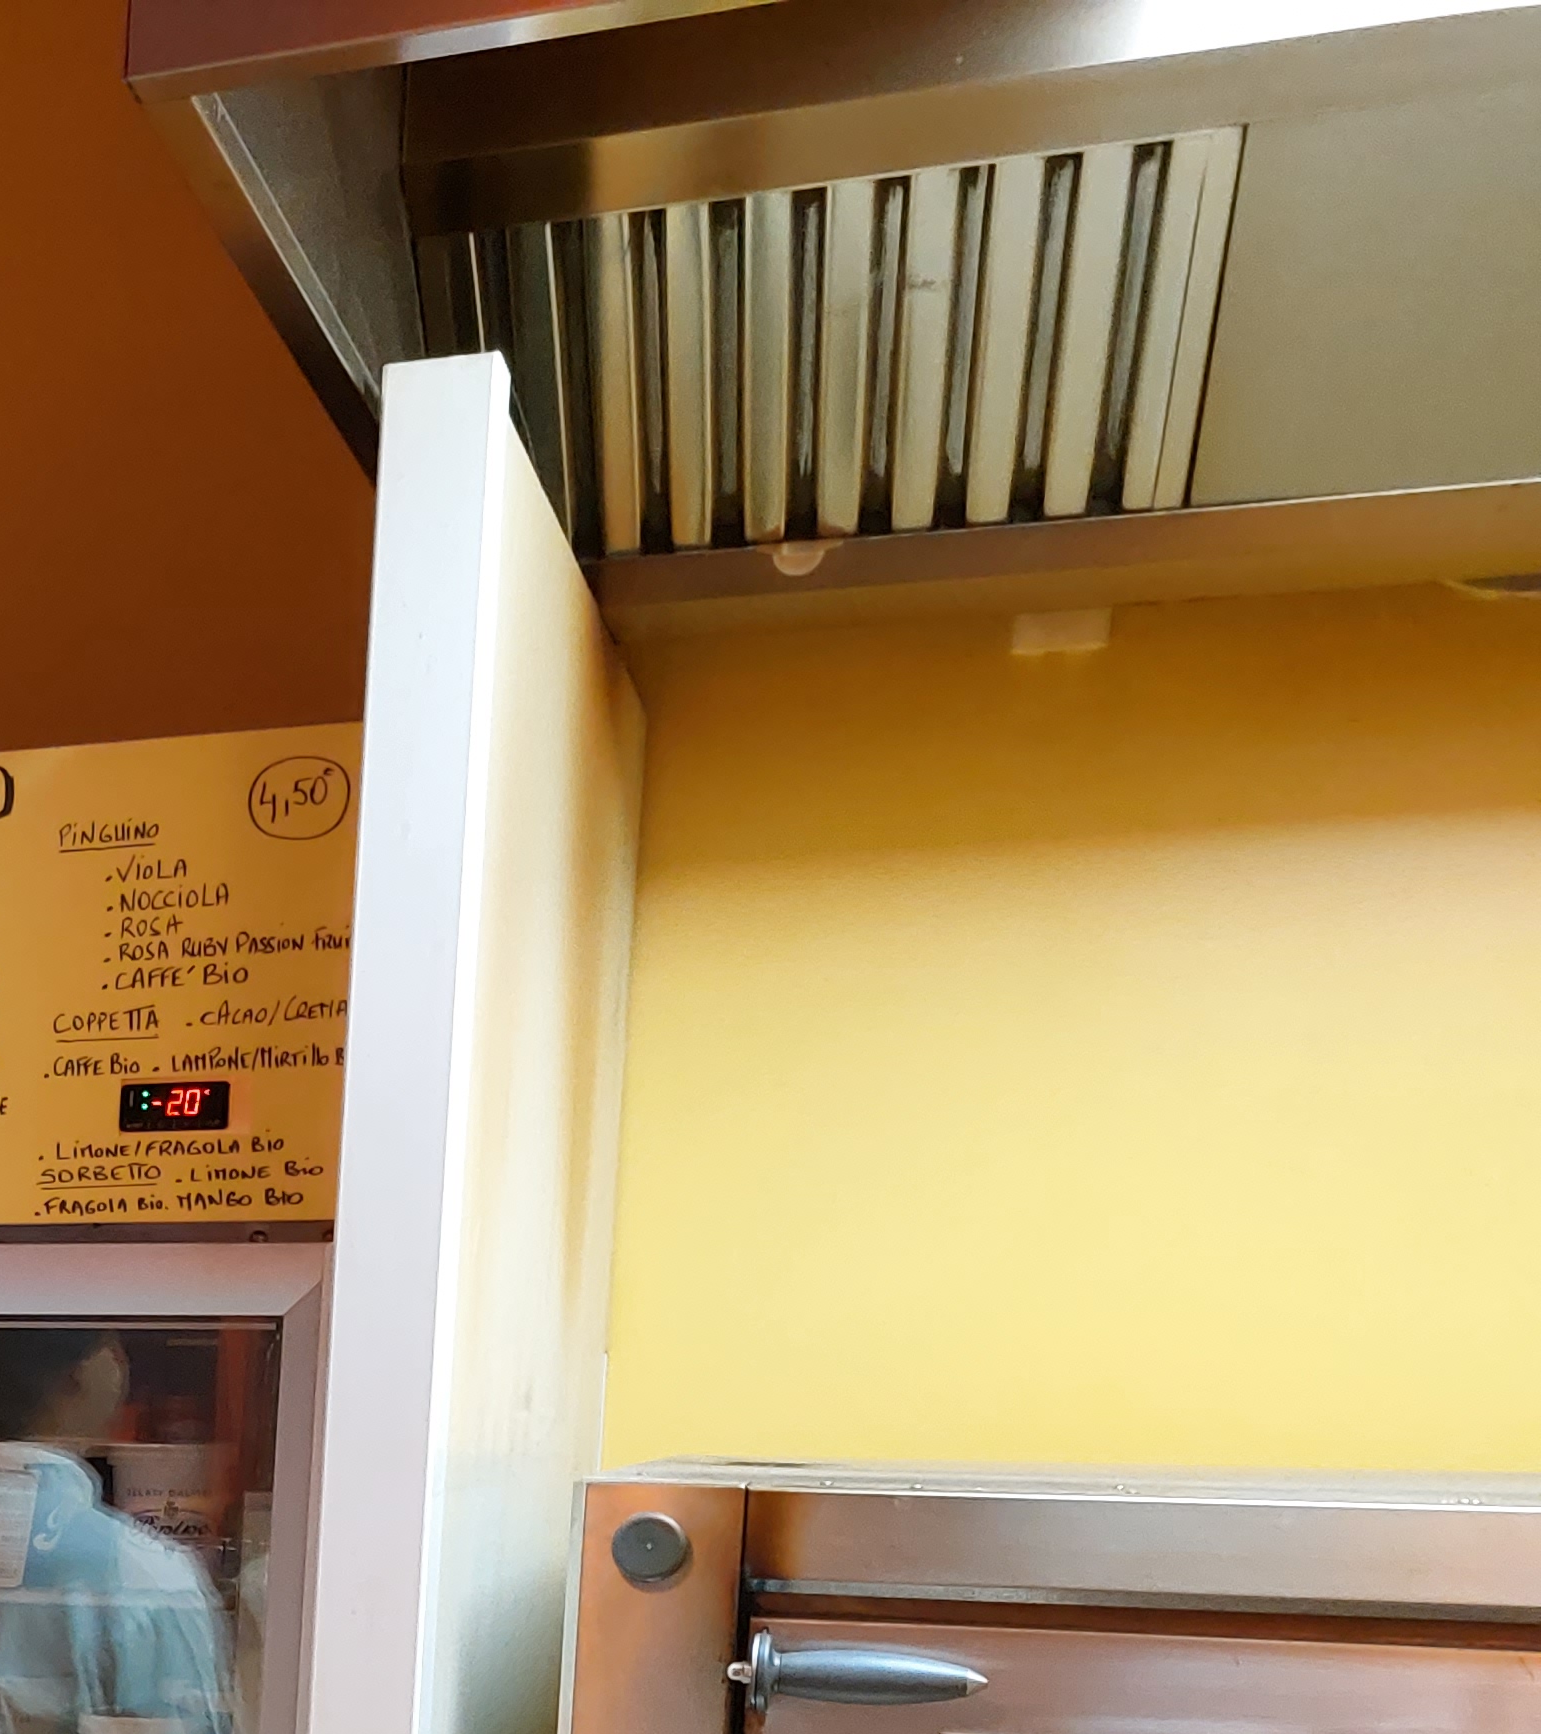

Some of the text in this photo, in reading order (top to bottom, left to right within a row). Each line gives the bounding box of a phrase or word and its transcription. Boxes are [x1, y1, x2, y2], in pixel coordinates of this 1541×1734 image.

[121, 914, 183, 939] ROSA
[119, 941, 169, 963] ROSA
[181, 936, 228, 957] RUBY
[53, 1004, 159, 1034] COPPETTA
[53, 1056, 105, 1078] CAFFE
[40, 1162, 161, 1184] SORBETTO
[177, 1191, 252, 1211] MANGO
